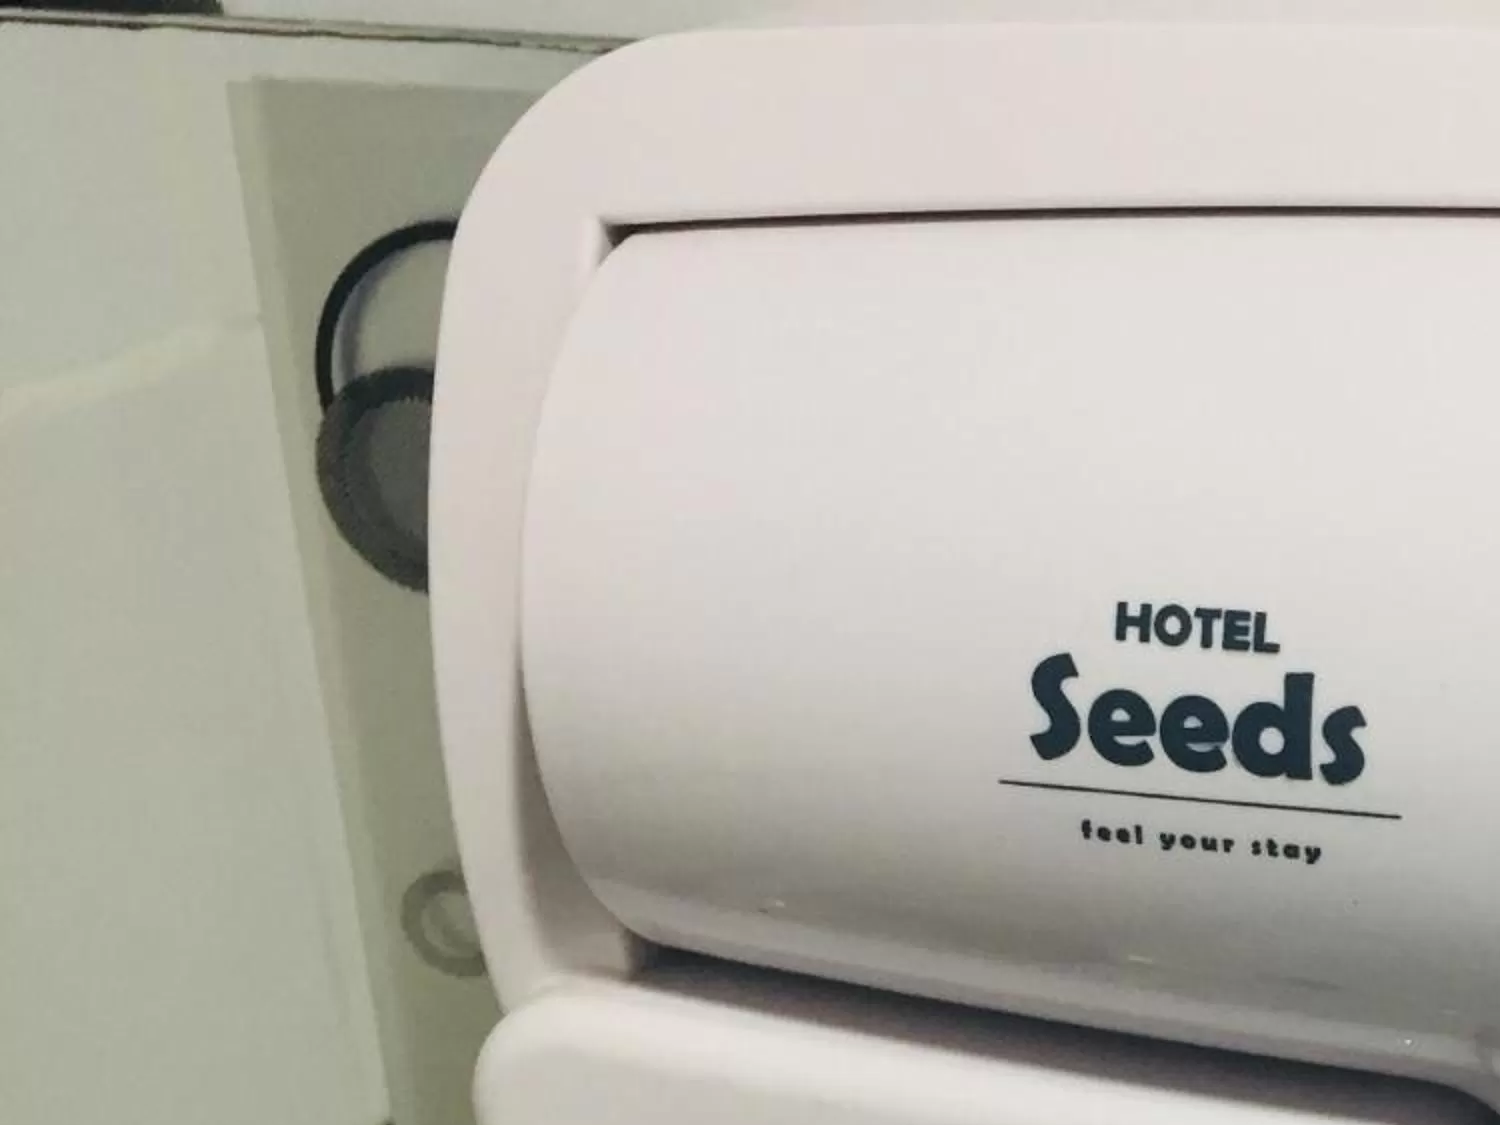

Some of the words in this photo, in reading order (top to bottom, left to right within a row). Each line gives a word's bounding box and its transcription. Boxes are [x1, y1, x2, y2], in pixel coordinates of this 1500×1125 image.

[1114, 600, 1281, 655] HOTEL
[1029, 652, 1368, 786] Seeds
[1080, 819, 1144, 846] feel
[1159, 831, 1236, 854] your
[1250, 838, 1322, 865] stay
